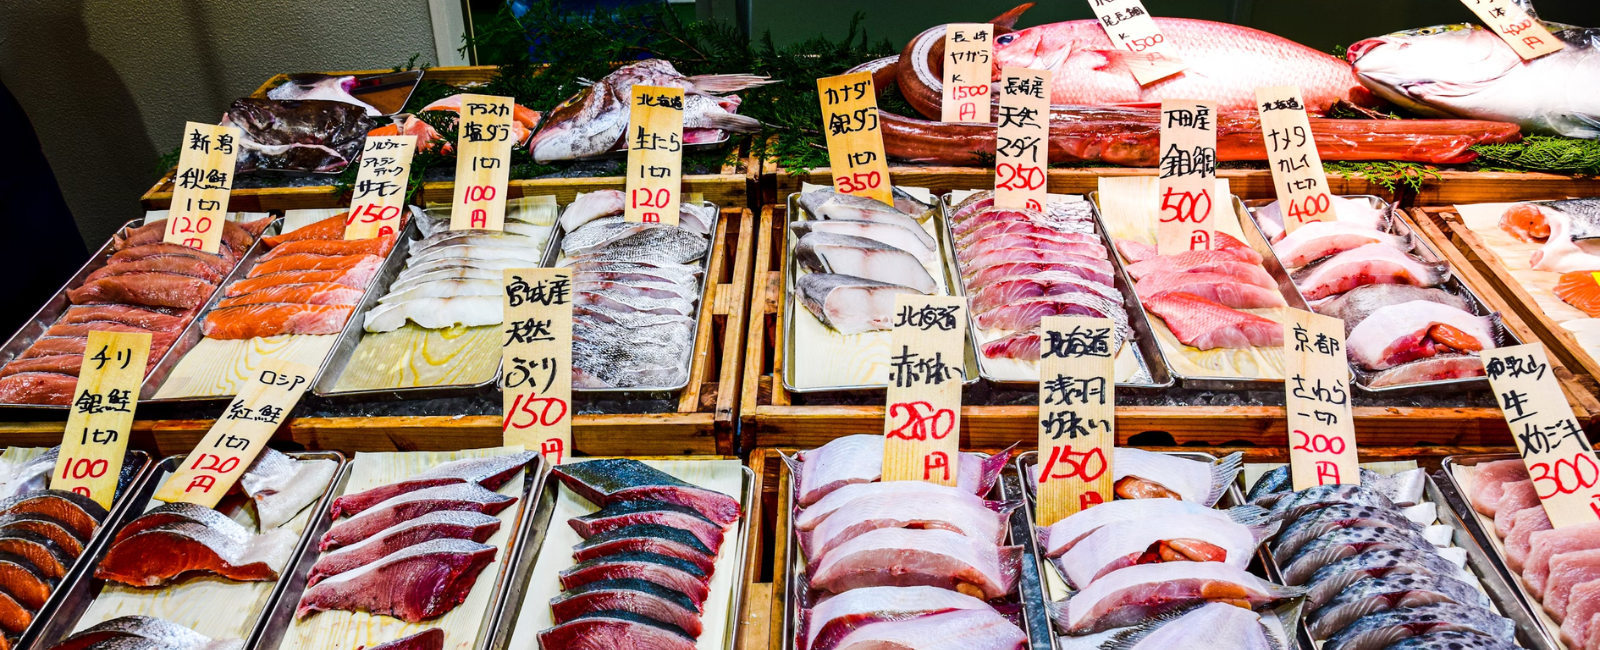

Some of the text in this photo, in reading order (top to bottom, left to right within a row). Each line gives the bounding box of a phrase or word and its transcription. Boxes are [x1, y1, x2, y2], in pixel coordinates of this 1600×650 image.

[951, 30, 989, 43] 長崎
[1521, 36, 1545, 50] 円
[824, 80, 871, 105] カナダ
[1004, 76, 1045, 99] 長崎産
[466, 103, 510, 117] アラスカ
[636, 93, 684, 111] 北海道
[959, 102, 976, 121] 円
[829, 106, 878, 136] 銀ダラ
[999, 106, 1042, 129] 天然
[1164, 105, 1211, 131] 下田産
[189, 128, 234, 155] 新潟
[462, 121, 511, 143] 塩ダラ
[632, 125, 681, 153] 生たら
[1267, 125, 1307, 153] ナメタ
[996, 136, 1041, 163] マダイ
[363, 157, 396, 168] アトラン
[1278, 154, 1310, 173] カレイ
[178, 167, 231, 191] 秋鮭
[836, 171, 881, 194] 350
[996, 163, 1046, 191] 250
[464, 185, 496, 204] 100
[632, 187, 671, 210] 120
[1159, 187, 1212, 224] 500
[345, 203, 400, 226] 150
[470, 209, 487, 229] 円
[1288, 192, 1331, 223] 400
[171, 216, 212, 235] 120
[1190, 229, 1210, 250] 円
[502, 317, 556, 347] 天然
[1293, 322, 1340, 357] 京都
[90, 345, 132, 370] チリ
[259, 370, 306, 391] ロシア
[504, 356, 558, 395] ぶり
[74, 388, 132, 414] 銀鮭
[1044, 373, 1106, 405] 浅羽
[1292, 374, 1347, 405] さわら
[227, 399, 284, 425] 紅鮭
[502, 391, 568, 433] 150
[1501, 389, 1539, 424] 生
[886, 400, 957, 442] 280
[1293, 429, 1346, 455] 200
[1518, 418, 1590, 459] メカジキ
[190, 453, 241, 474] 120
[541, 437, 565, 466] 円
[1038, 444, 1108, 483] 150
[62, 457, 109, 480] 100
[922, 451, 951, 481] 円
[1315, 461, 1341, 486] 円
[1529, 452, 1599, 500] 300
[184, 474, 217, 494] 円
